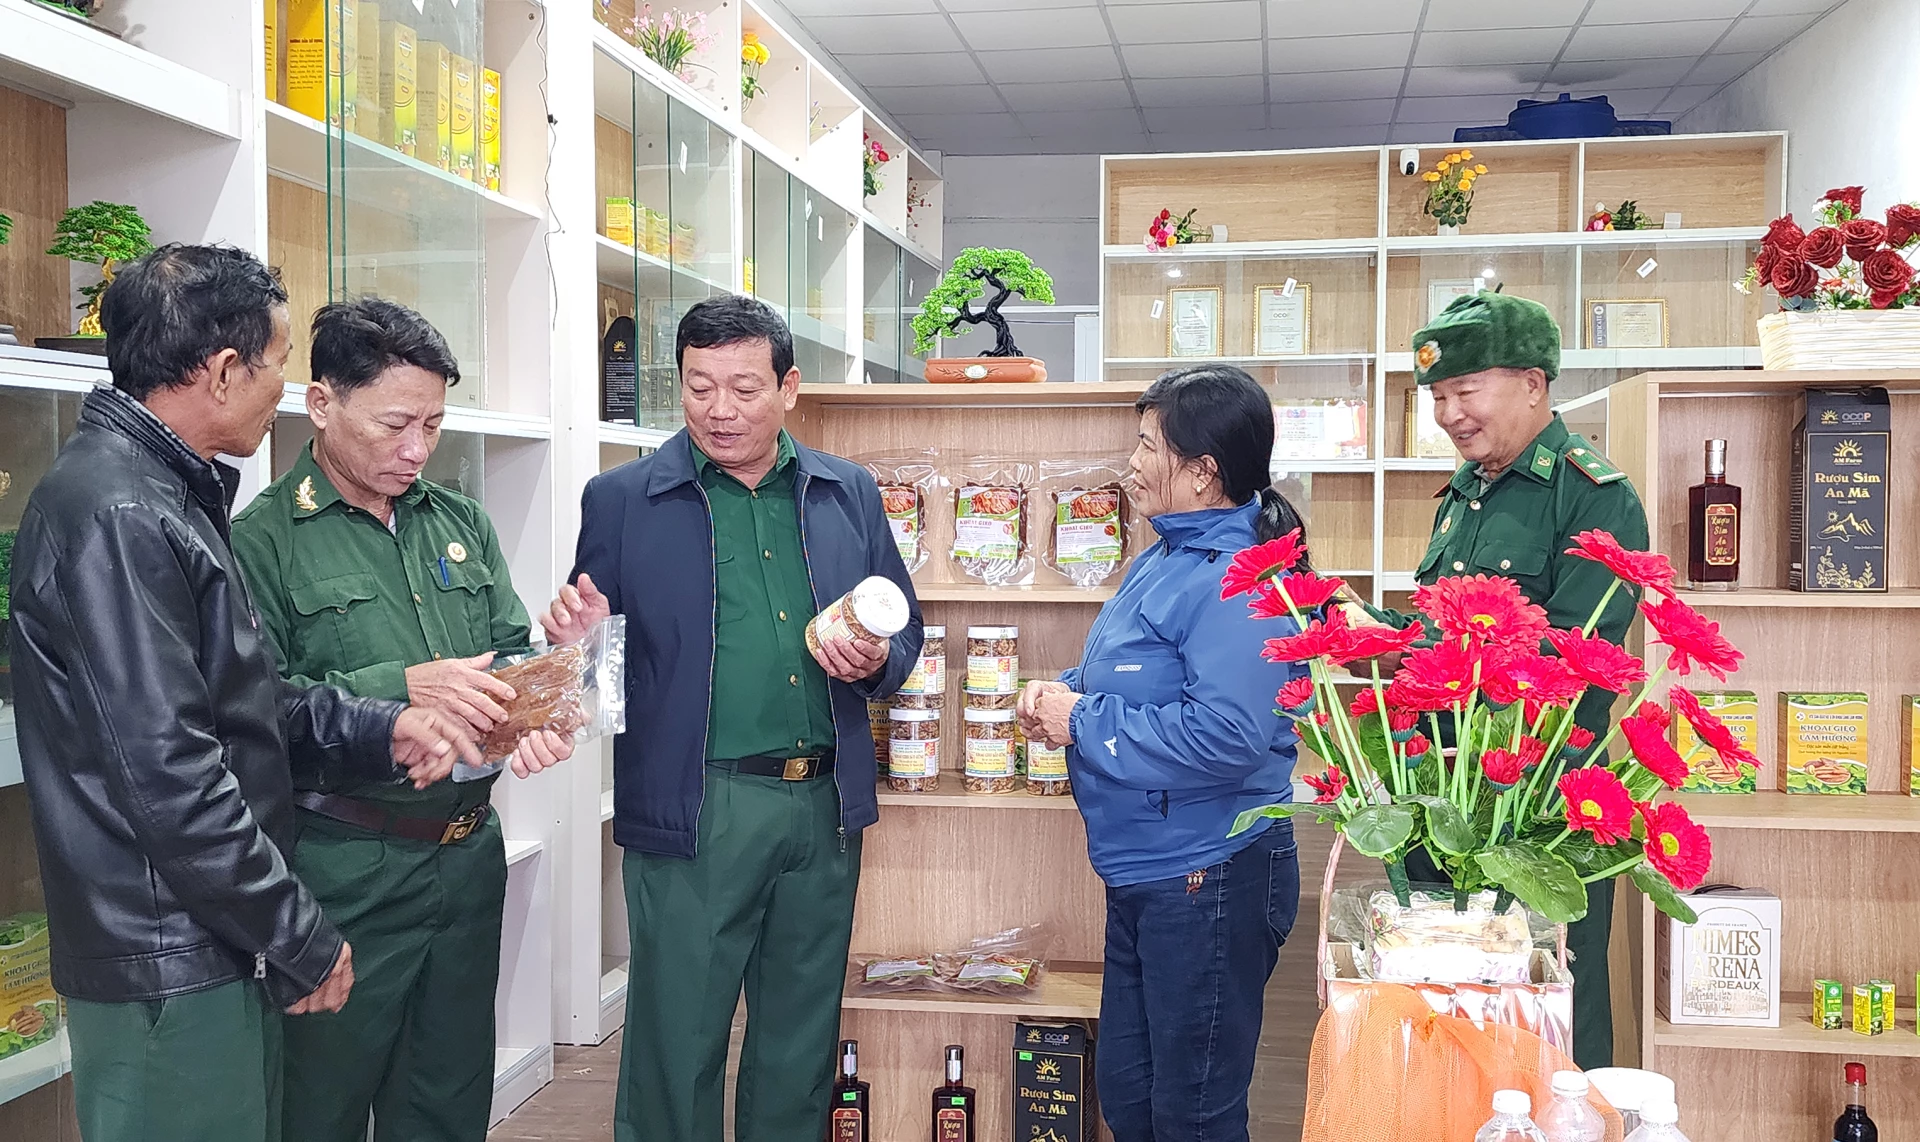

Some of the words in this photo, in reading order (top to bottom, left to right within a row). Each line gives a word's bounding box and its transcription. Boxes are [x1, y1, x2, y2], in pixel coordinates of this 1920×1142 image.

[1842, 412, 1872, 420] OCOP
[1815, 472, 1849, 485] Rượu
[1853, 472, 1881, 483] Sim
[1824, 488, 1844, 498] An
[1848, 488, 1870, 498] Mã
[1692, 928, 1761, 956] NIMES
[1690, 956, 1762, 979] ARENA
[1690, 979, 1760, 990] BORDEAUX
[1045, 1033, 1069, 1042] OCOP
[1020, 1087, 1049, 1100] Rượu
[1053, 1090, 1076, 1102] Sim
[1029, 1102, 1045, 1113] An
[1048, 1104, 1067, 1115] Mã
